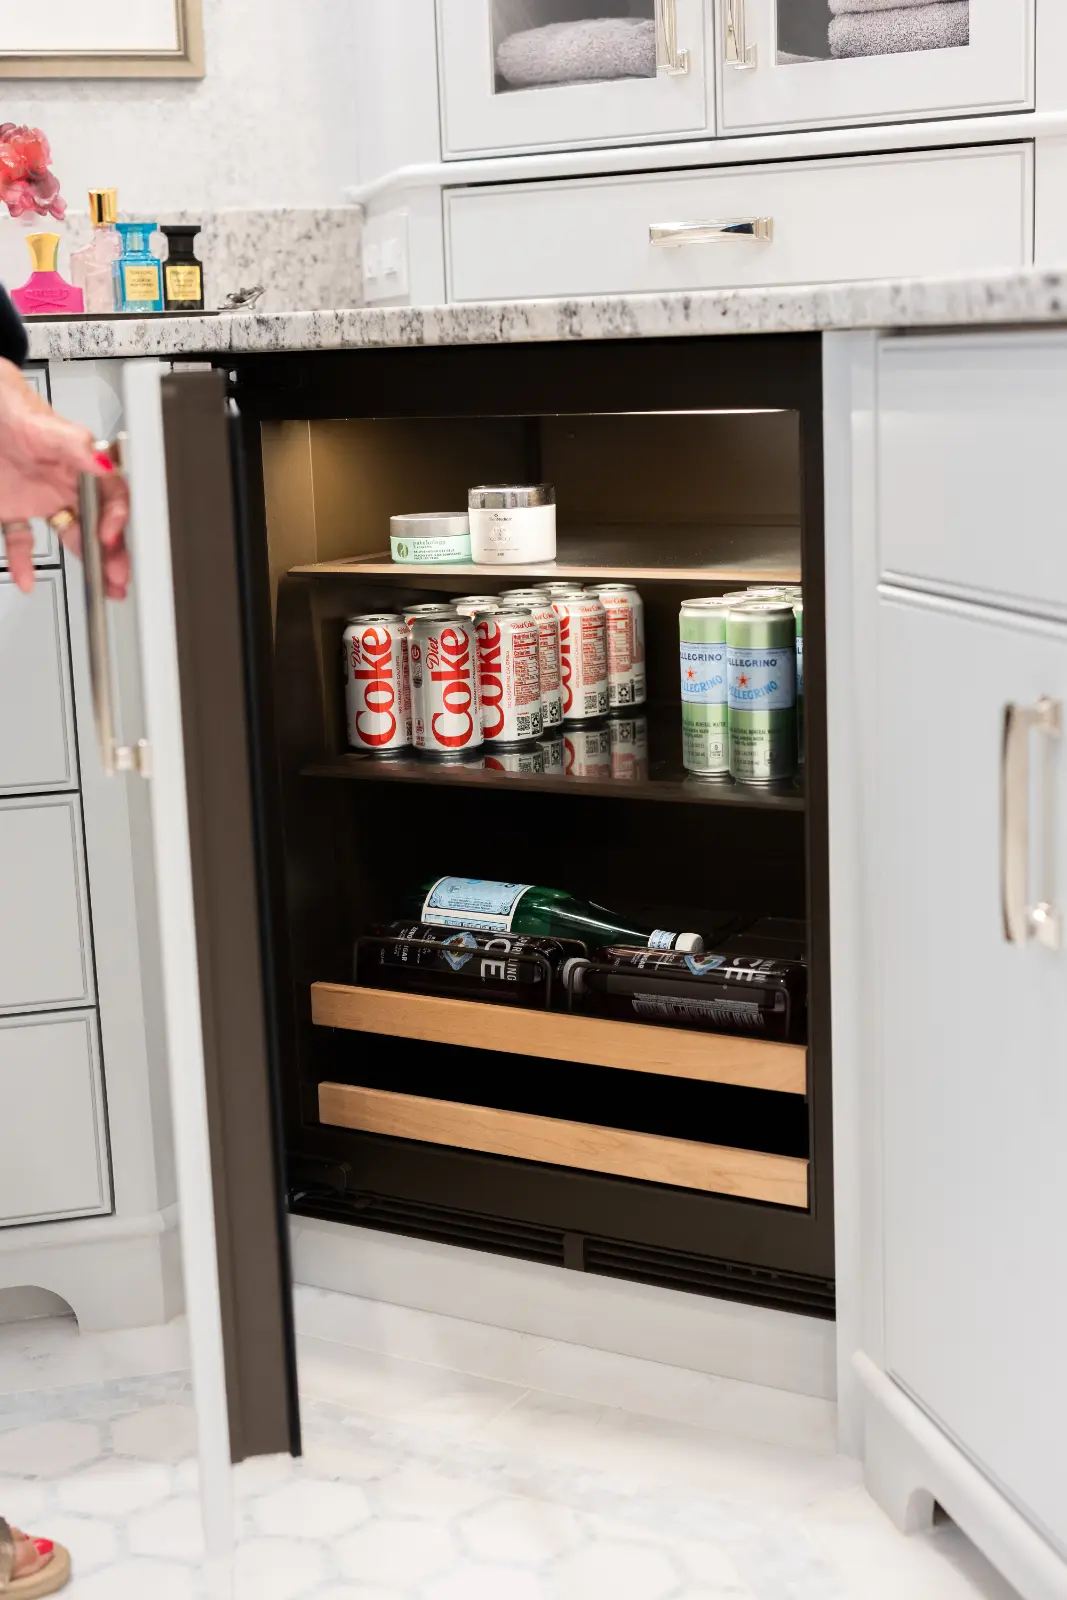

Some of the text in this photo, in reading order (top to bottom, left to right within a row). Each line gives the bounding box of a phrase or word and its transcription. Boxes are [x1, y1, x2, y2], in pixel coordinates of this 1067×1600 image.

[351, 636, 361, 669] Diet
[425, 636, 440, 670] Diet
[728, 658, 777, 667] ELLEGRINO
[355, 626, 397, 747] Coke
[431, 626, 474, 748] Coke
